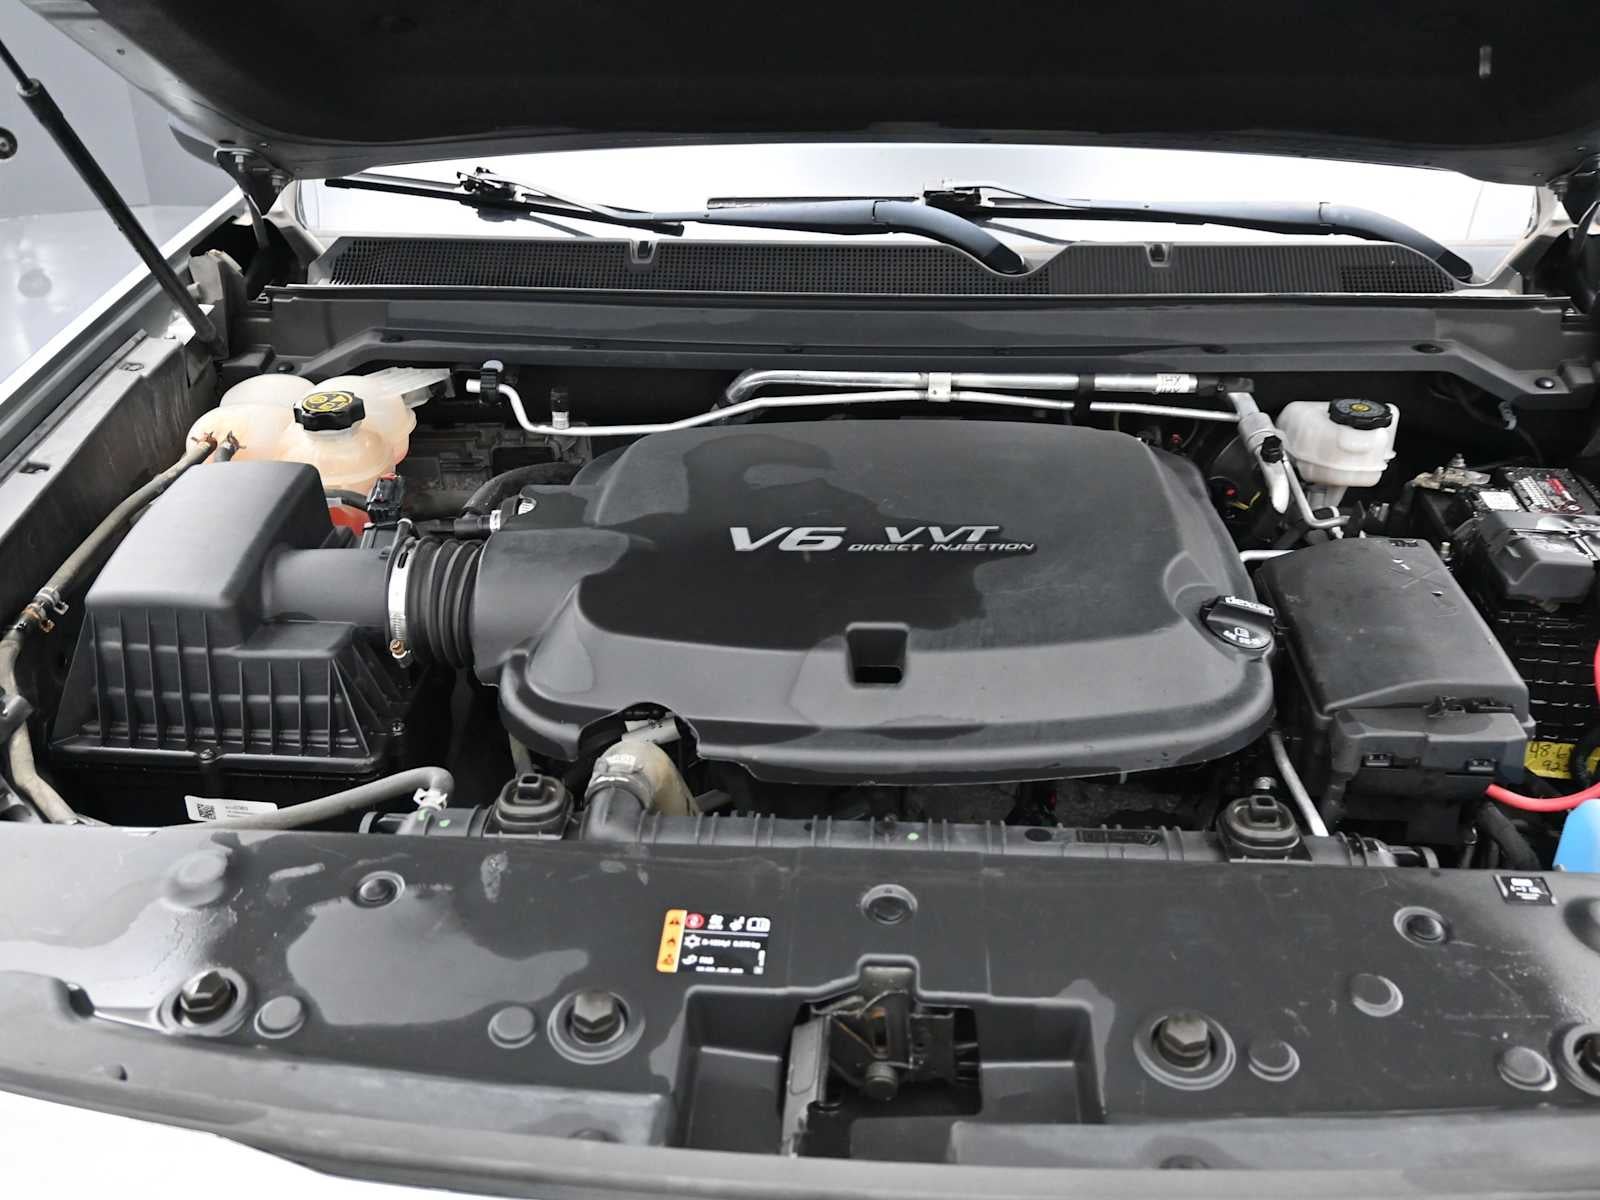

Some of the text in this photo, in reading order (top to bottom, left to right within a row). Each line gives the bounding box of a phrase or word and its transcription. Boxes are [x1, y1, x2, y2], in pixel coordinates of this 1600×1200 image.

[729, 526, 1000, 551] V6 VVT
[848, 543, 1035, 551] DIRECT INJECTION
